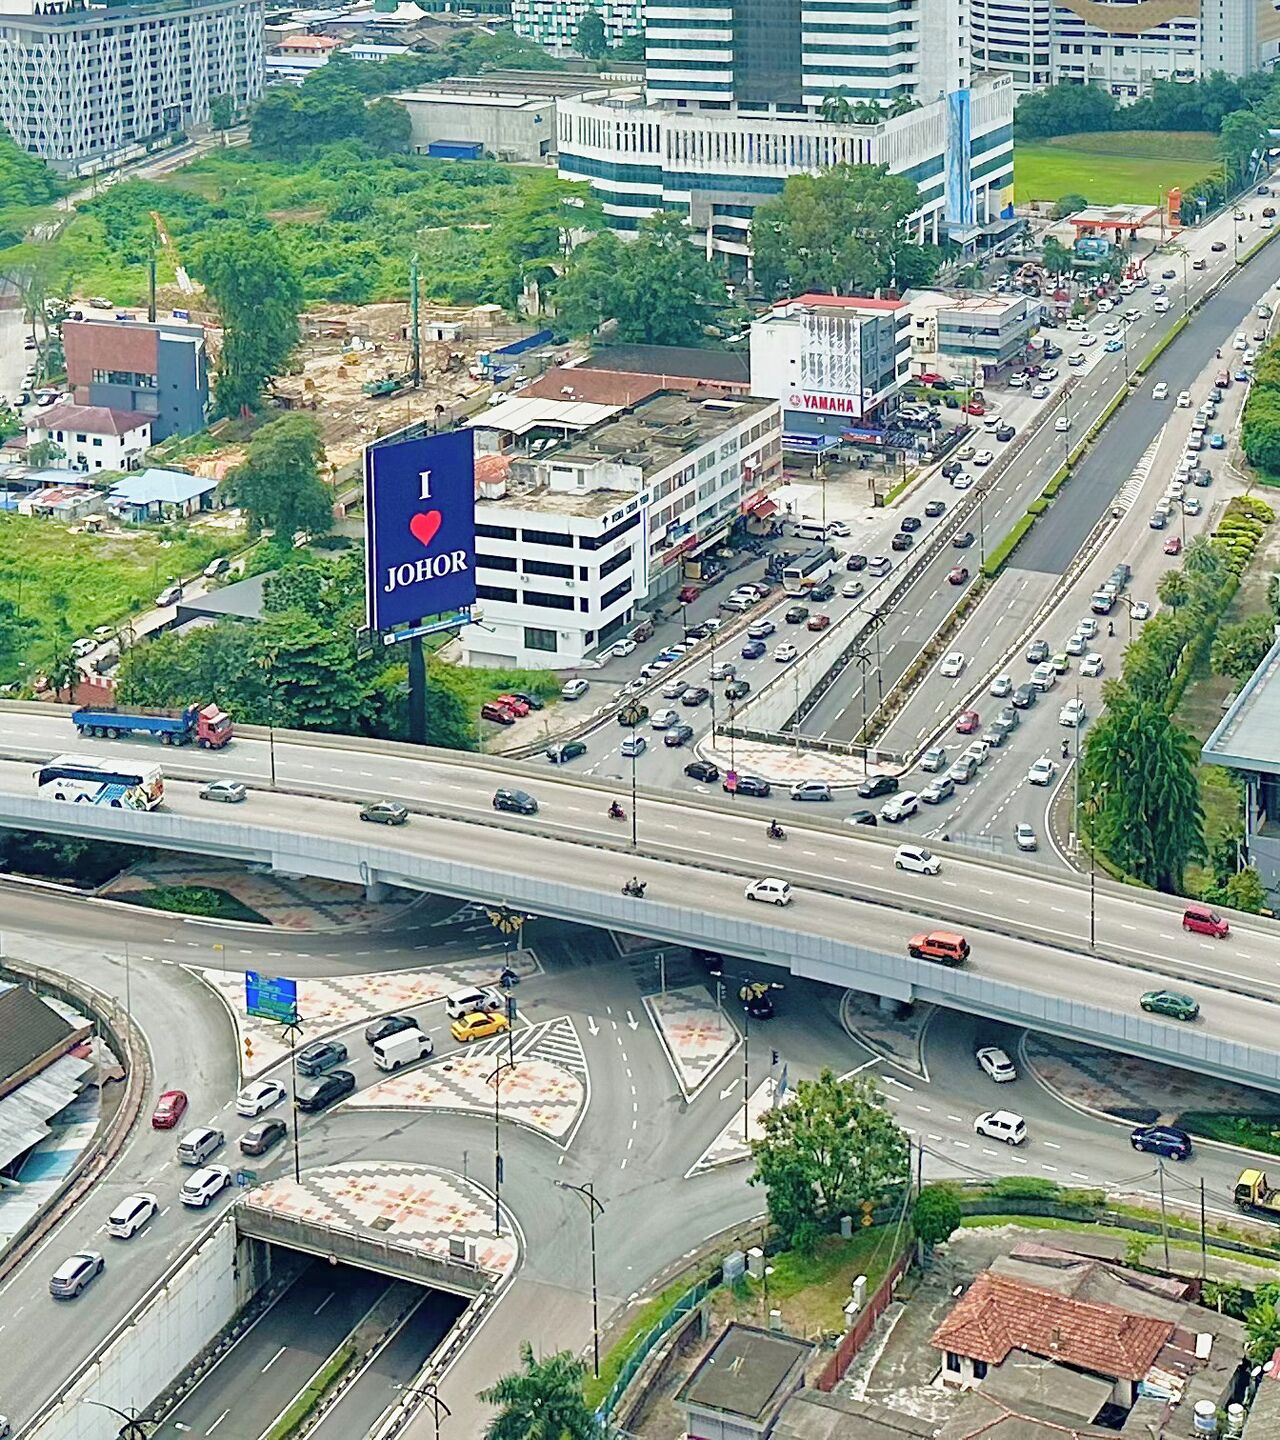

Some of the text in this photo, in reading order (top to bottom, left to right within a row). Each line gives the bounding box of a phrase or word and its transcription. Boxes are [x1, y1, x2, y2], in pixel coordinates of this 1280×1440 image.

[803, 394, 854, 413] YAMAHA
[418, 470, 432, 500] I
[384, 549, 468, 593] JOHOR
